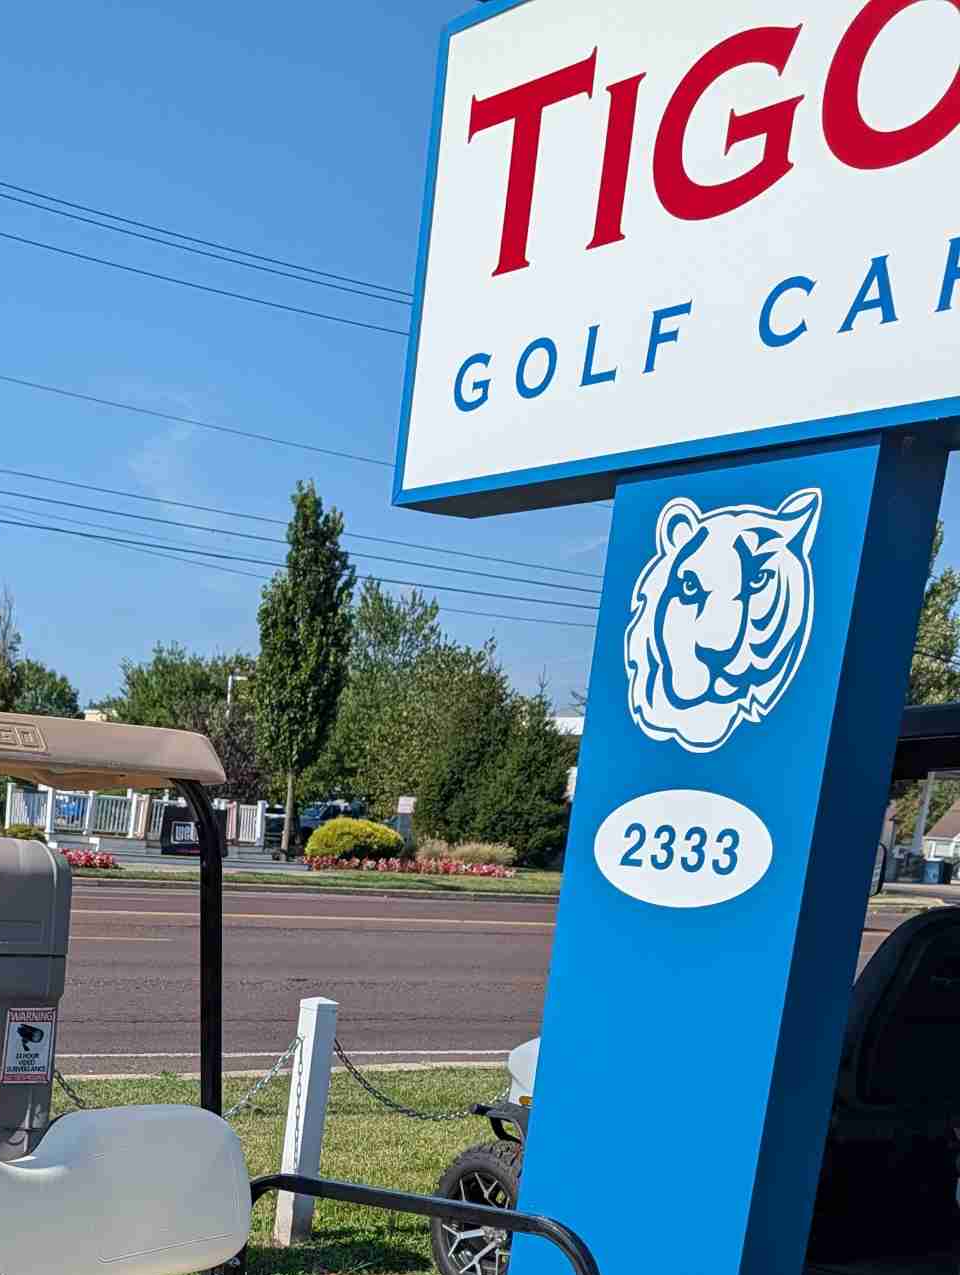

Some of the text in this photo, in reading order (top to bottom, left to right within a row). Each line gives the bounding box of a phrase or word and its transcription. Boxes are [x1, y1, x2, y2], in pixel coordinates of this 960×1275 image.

[453, 299, 693, 413] GOLF
[620, 822, 740, 876] 2333
[9, 1010, 53, 1022] WARNING
